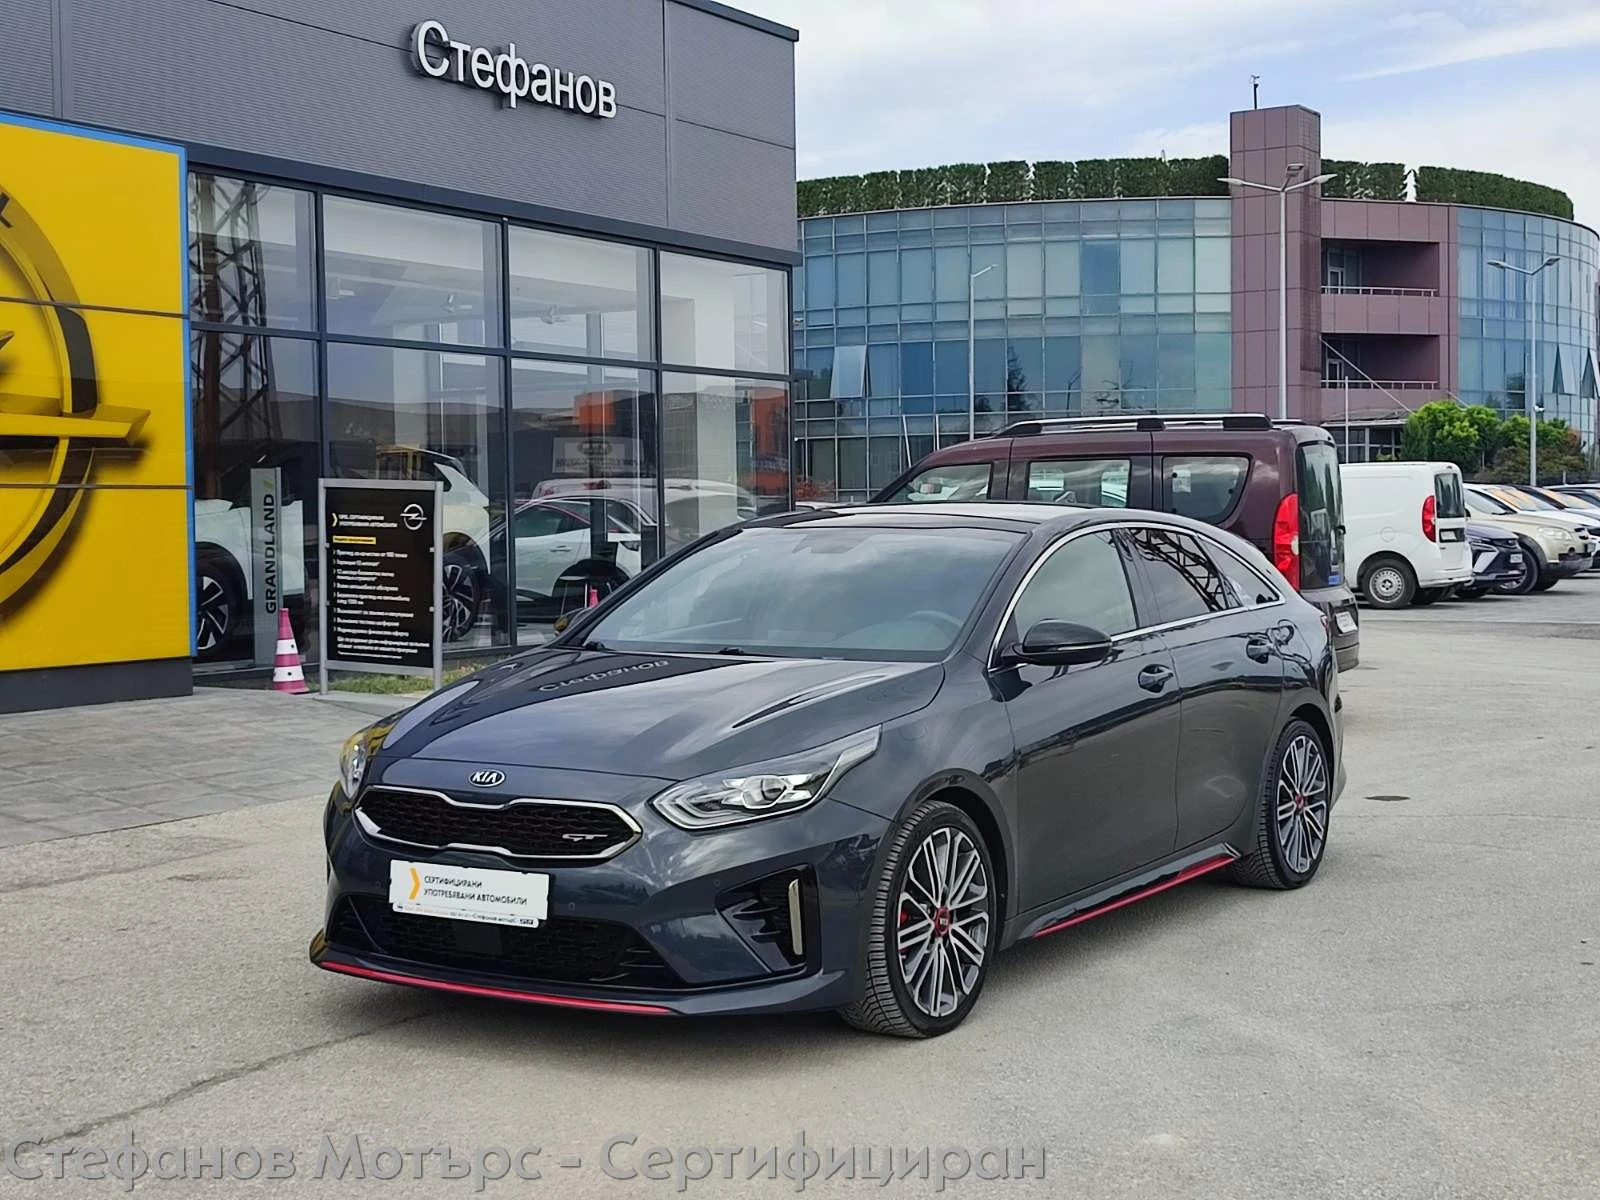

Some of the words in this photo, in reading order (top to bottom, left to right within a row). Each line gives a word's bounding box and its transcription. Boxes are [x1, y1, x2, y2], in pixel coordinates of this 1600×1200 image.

[414, 20, 617, 118] Стефанов
[263, 494, 277, 614] GRANDLAND
[471, 770, 499, 784] KIA
[561, 832, 609, 842] GT
[424, 875, 483, 889] СЕРТИФИЦИРАНИ
[424, 888, 476, 901] УПОТРЕБЯВАНИ
[476, 893, 528, 905] АВТОМОБИЛИ
